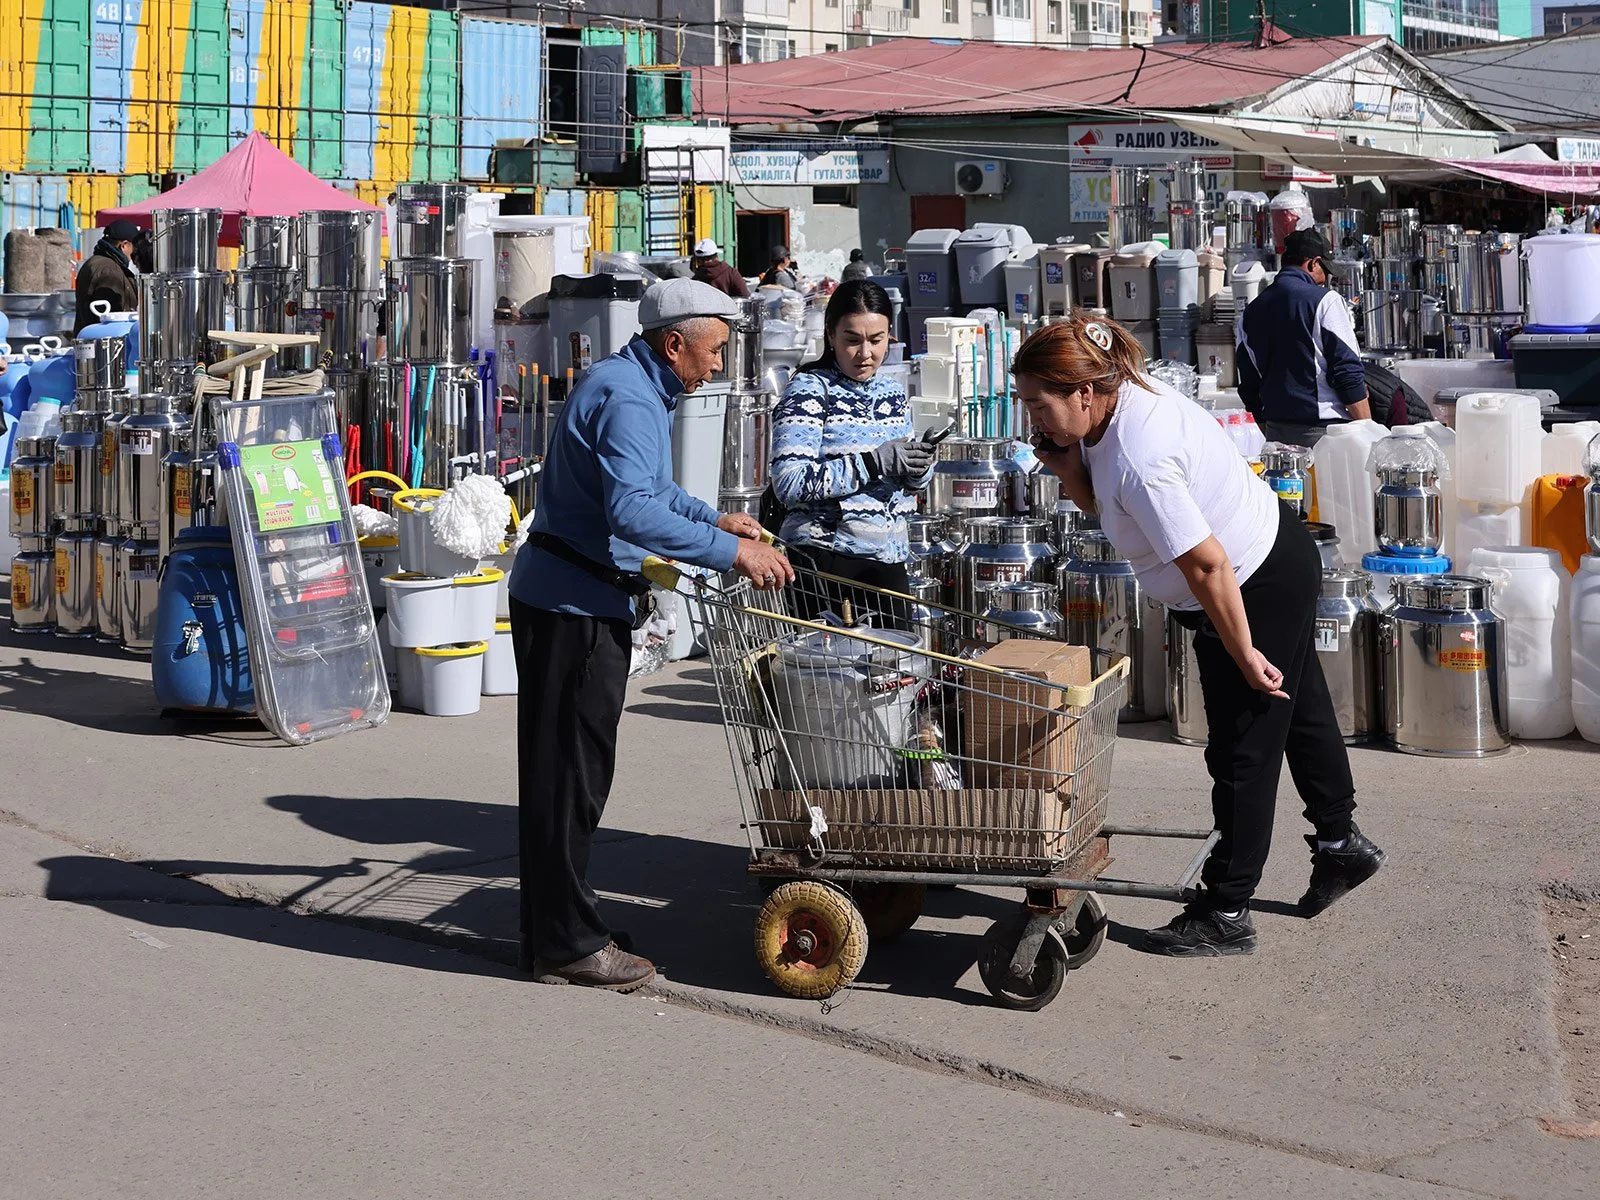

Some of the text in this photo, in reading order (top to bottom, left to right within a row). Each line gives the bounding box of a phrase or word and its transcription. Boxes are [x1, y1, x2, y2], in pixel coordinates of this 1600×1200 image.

[96, 3, 132, 21] 481
[1115, 132, 1165, 148] РАДИО
[814, 168, 883, 180] ГУТАЛ ЗАСВАР
